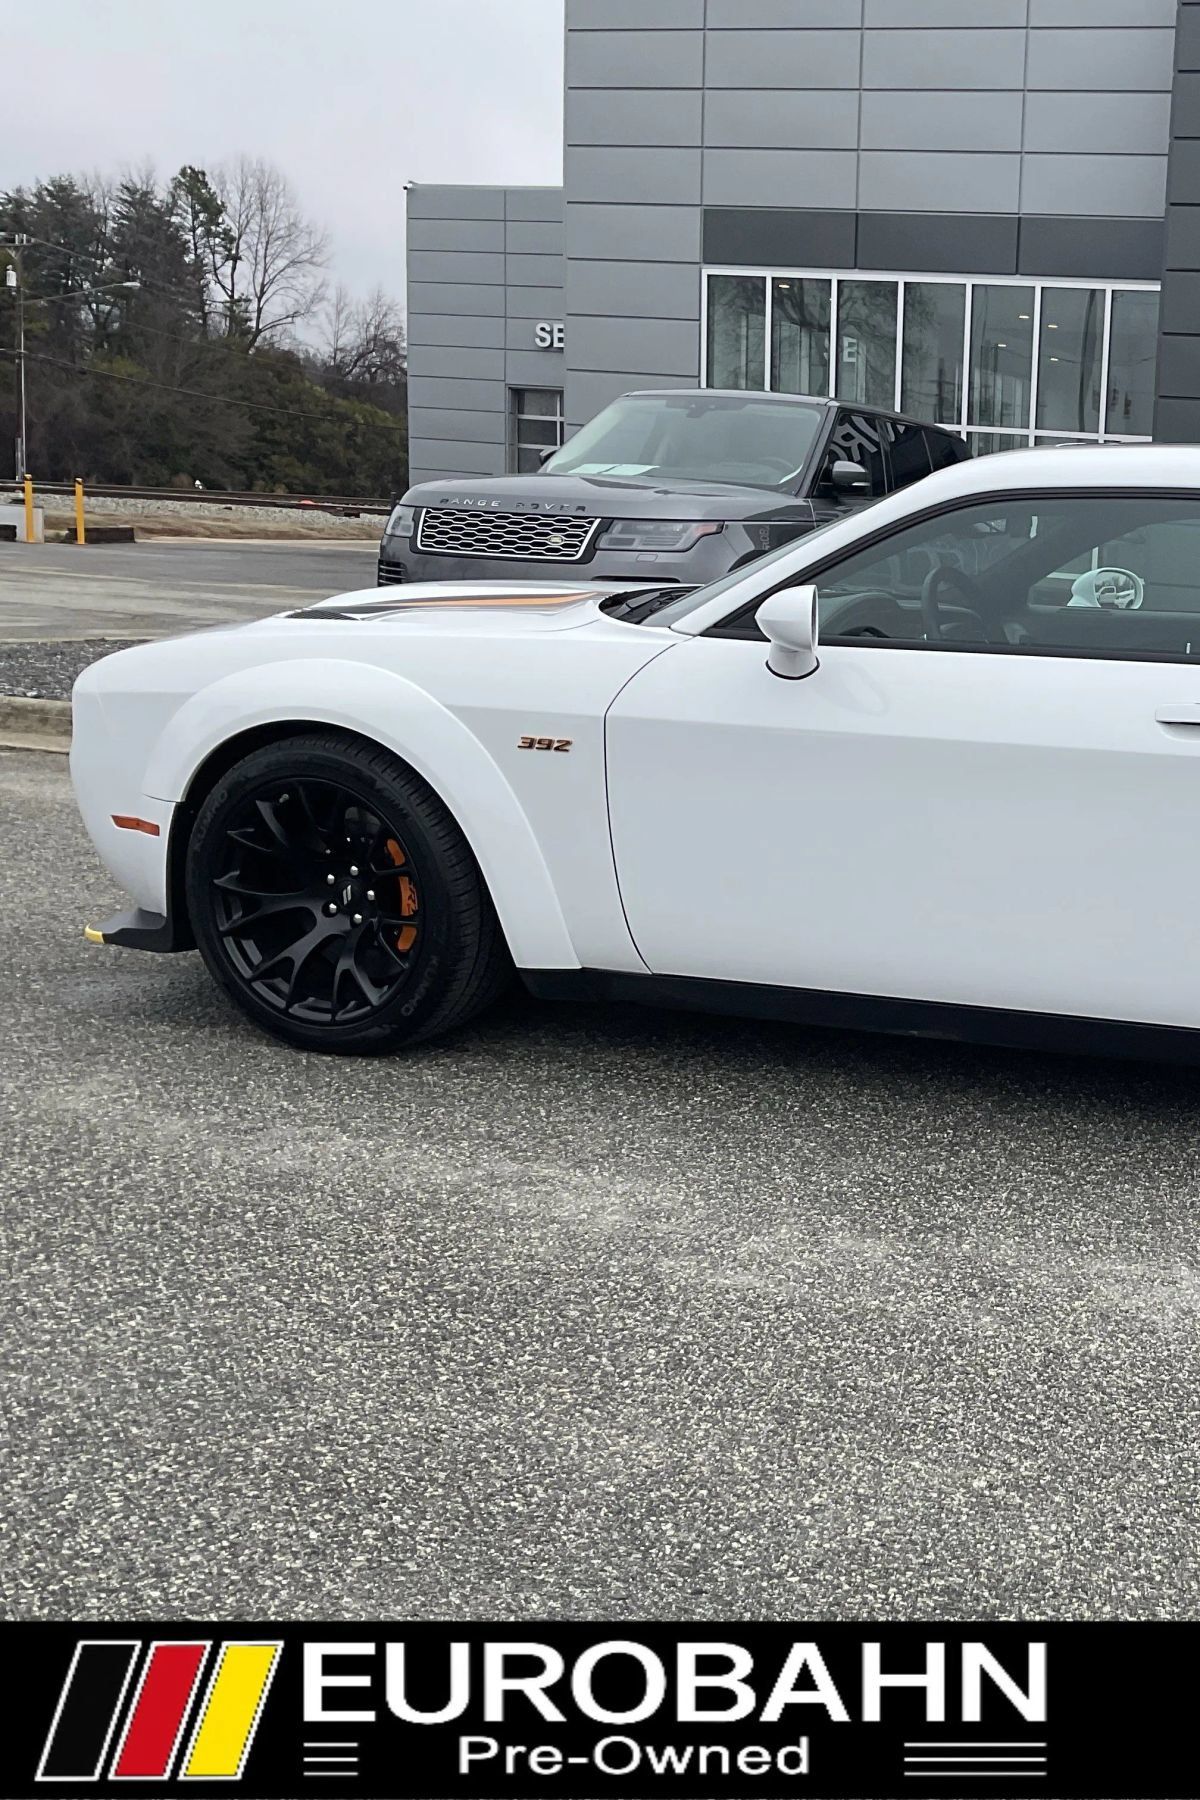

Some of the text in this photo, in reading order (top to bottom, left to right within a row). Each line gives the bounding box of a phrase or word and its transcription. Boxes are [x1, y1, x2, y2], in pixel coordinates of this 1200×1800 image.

[440, 498, 586, 513] RANGE ROVER
[517, 736, 573, 753] 392
